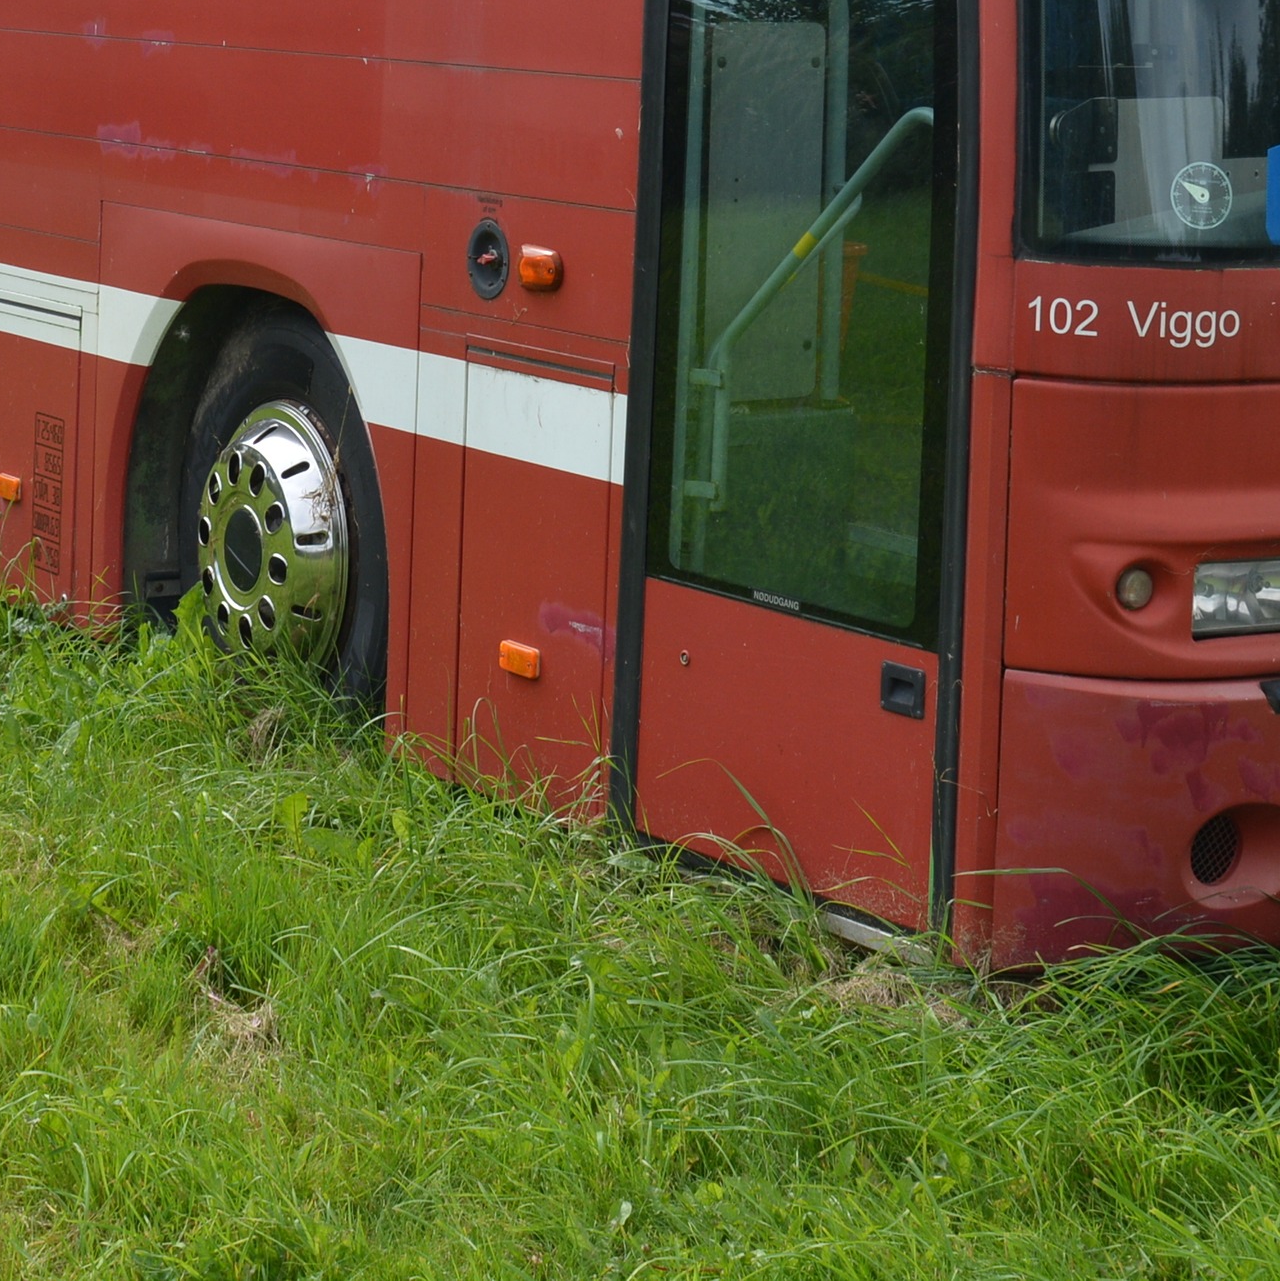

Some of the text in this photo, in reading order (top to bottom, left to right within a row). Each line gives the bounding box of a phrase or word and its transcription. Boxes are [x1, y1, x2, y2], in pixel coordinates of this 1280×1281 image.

[1028, 295, 1241, 348] 102 Viggo
[753, 590, 800, 611] NØDUDGANG
